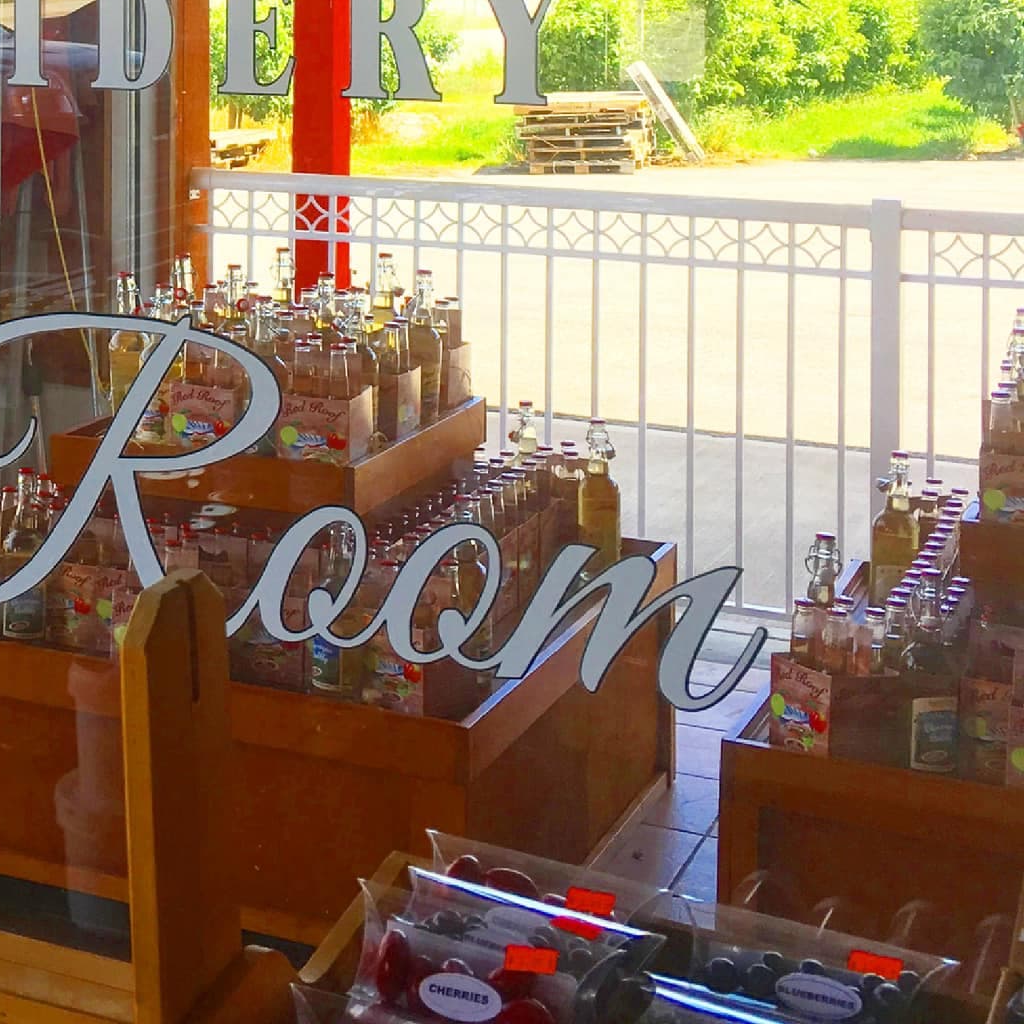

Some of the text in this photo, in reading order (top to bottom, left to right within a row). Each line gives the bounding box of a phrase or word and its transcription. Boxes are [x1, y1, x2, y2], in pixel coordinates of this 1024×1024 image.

[197, 390, 232, 411] Roof
[309, 403, 347, 422] Roof
[428, 982, 490, 1006] CHERRIES
[777, 985, 855, 1010] BLUEBERRIES
